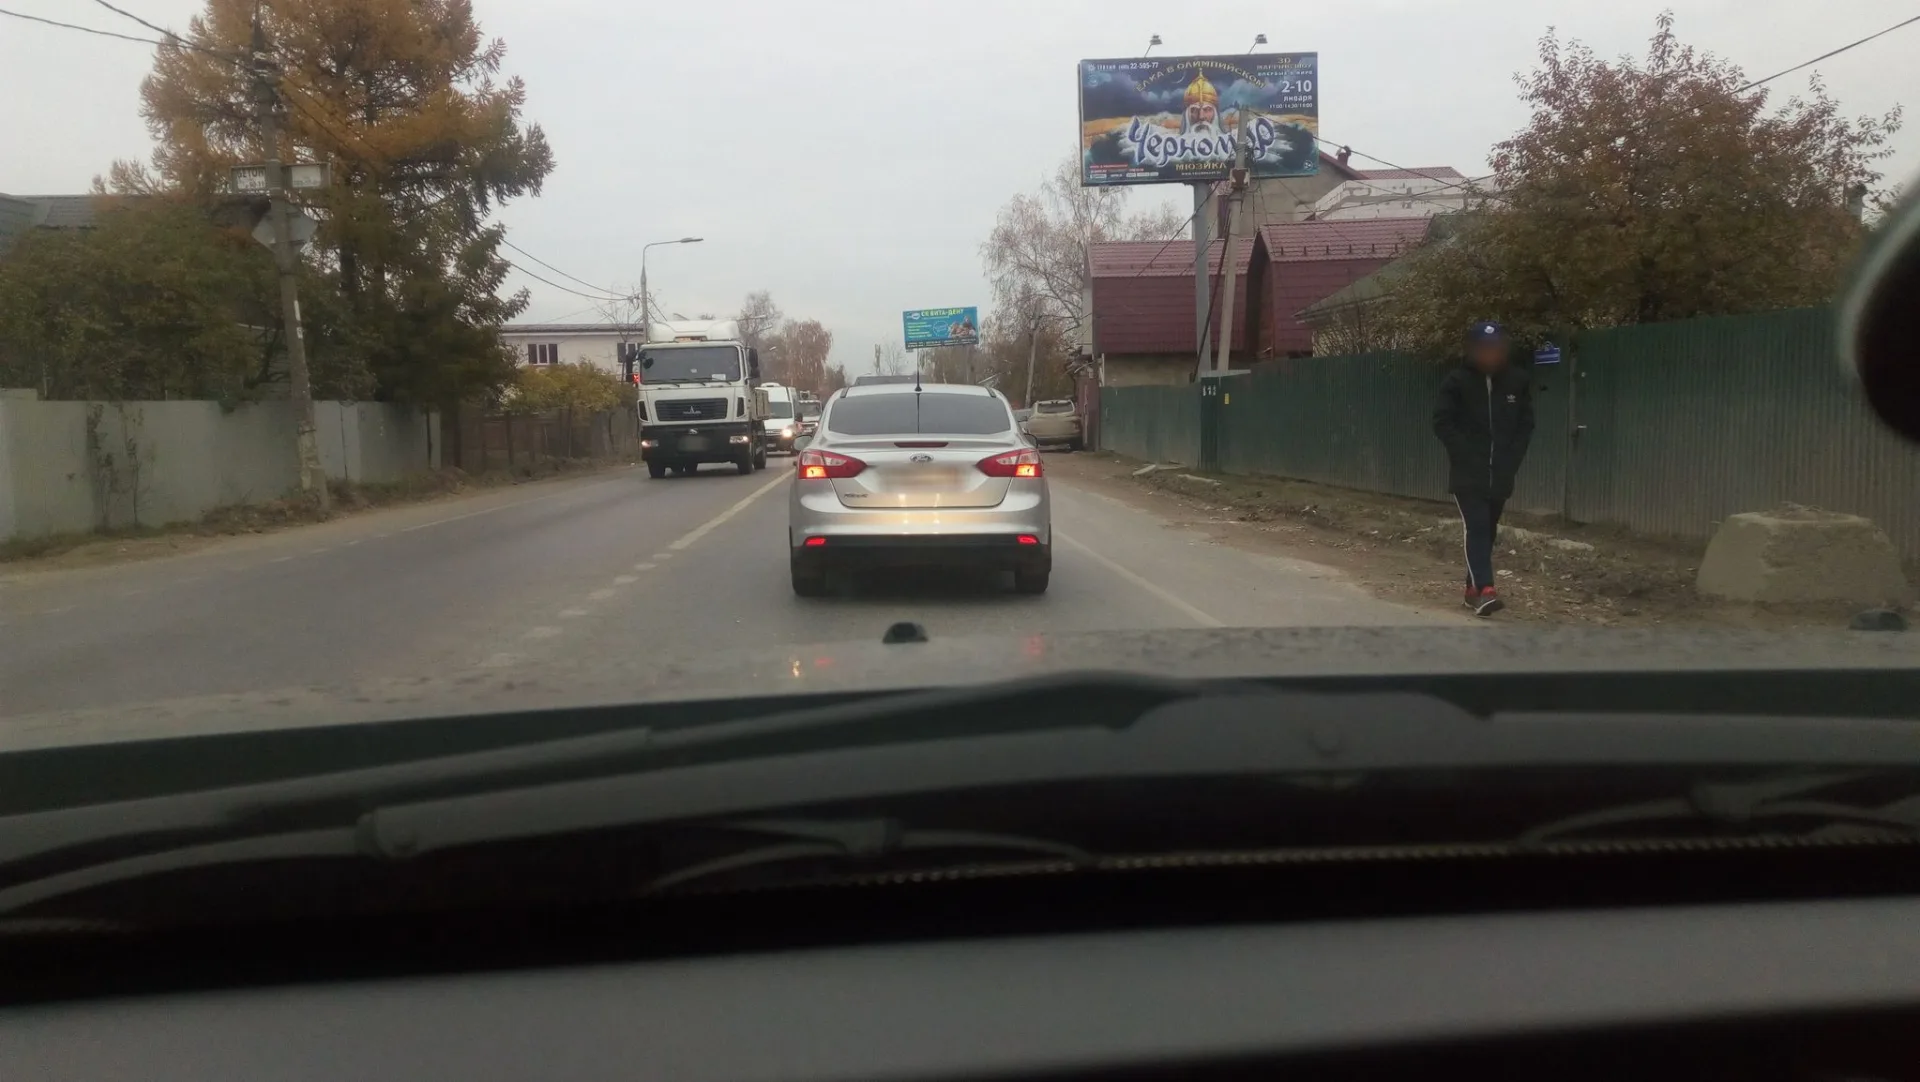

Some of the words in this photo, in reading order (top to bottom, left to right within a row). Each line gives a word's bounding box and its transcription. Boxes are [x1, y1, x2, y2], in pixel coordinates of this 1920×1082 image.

[1176, 60, 1265, 89] ОЛИМПИЙСКОМ
[1281, 79, 1313, 93] 2-10
[1283, 94, 1313, 103] января
